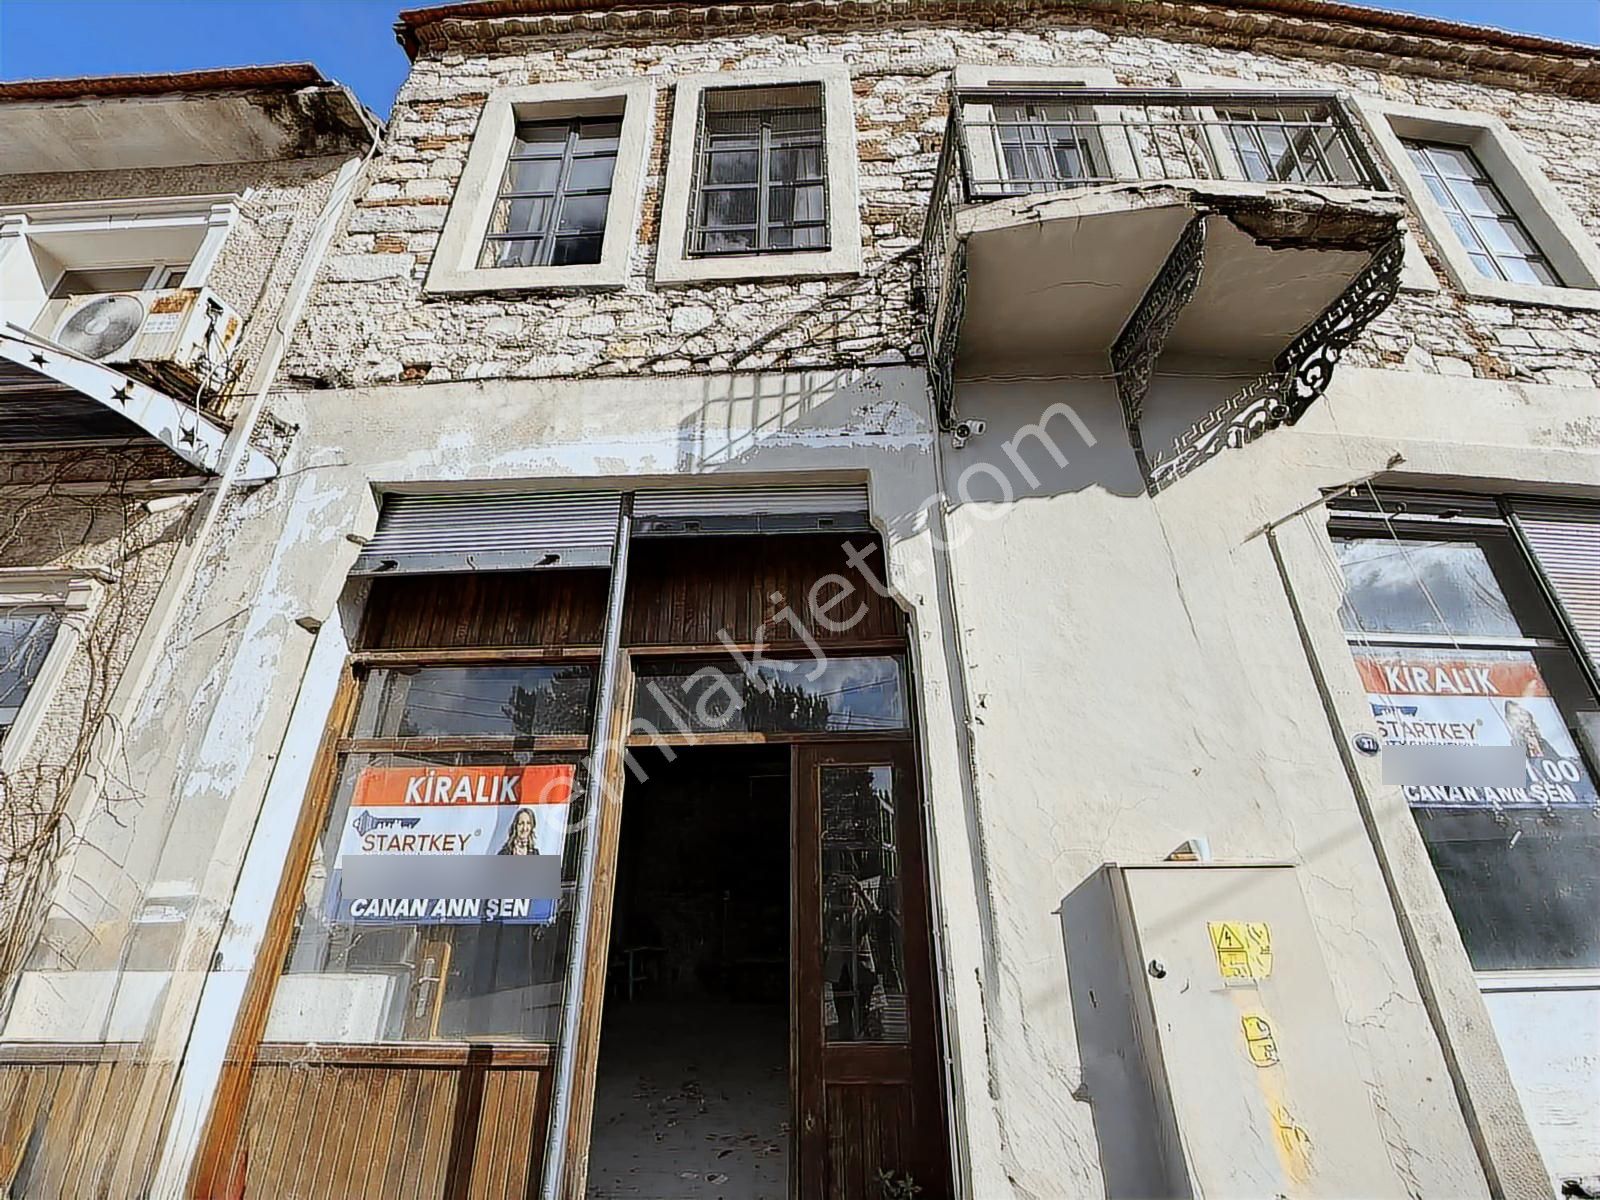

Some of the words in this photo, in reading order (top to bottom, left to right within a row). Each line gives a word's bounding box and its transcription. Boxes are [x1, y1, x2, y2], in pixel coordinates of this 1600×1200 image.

[1384, 661, 1499, 694] KİRALIK
[405, 771, 520, 804] KİRALIK
[1404, 785, 1479, 802] CANAN
[1484, 787, 1532, 803] ANN
[351, 898, 430, 918] CANAN
[431, 898, 480, 918] ANN
[486, 898, 531, 922] ŞEN
